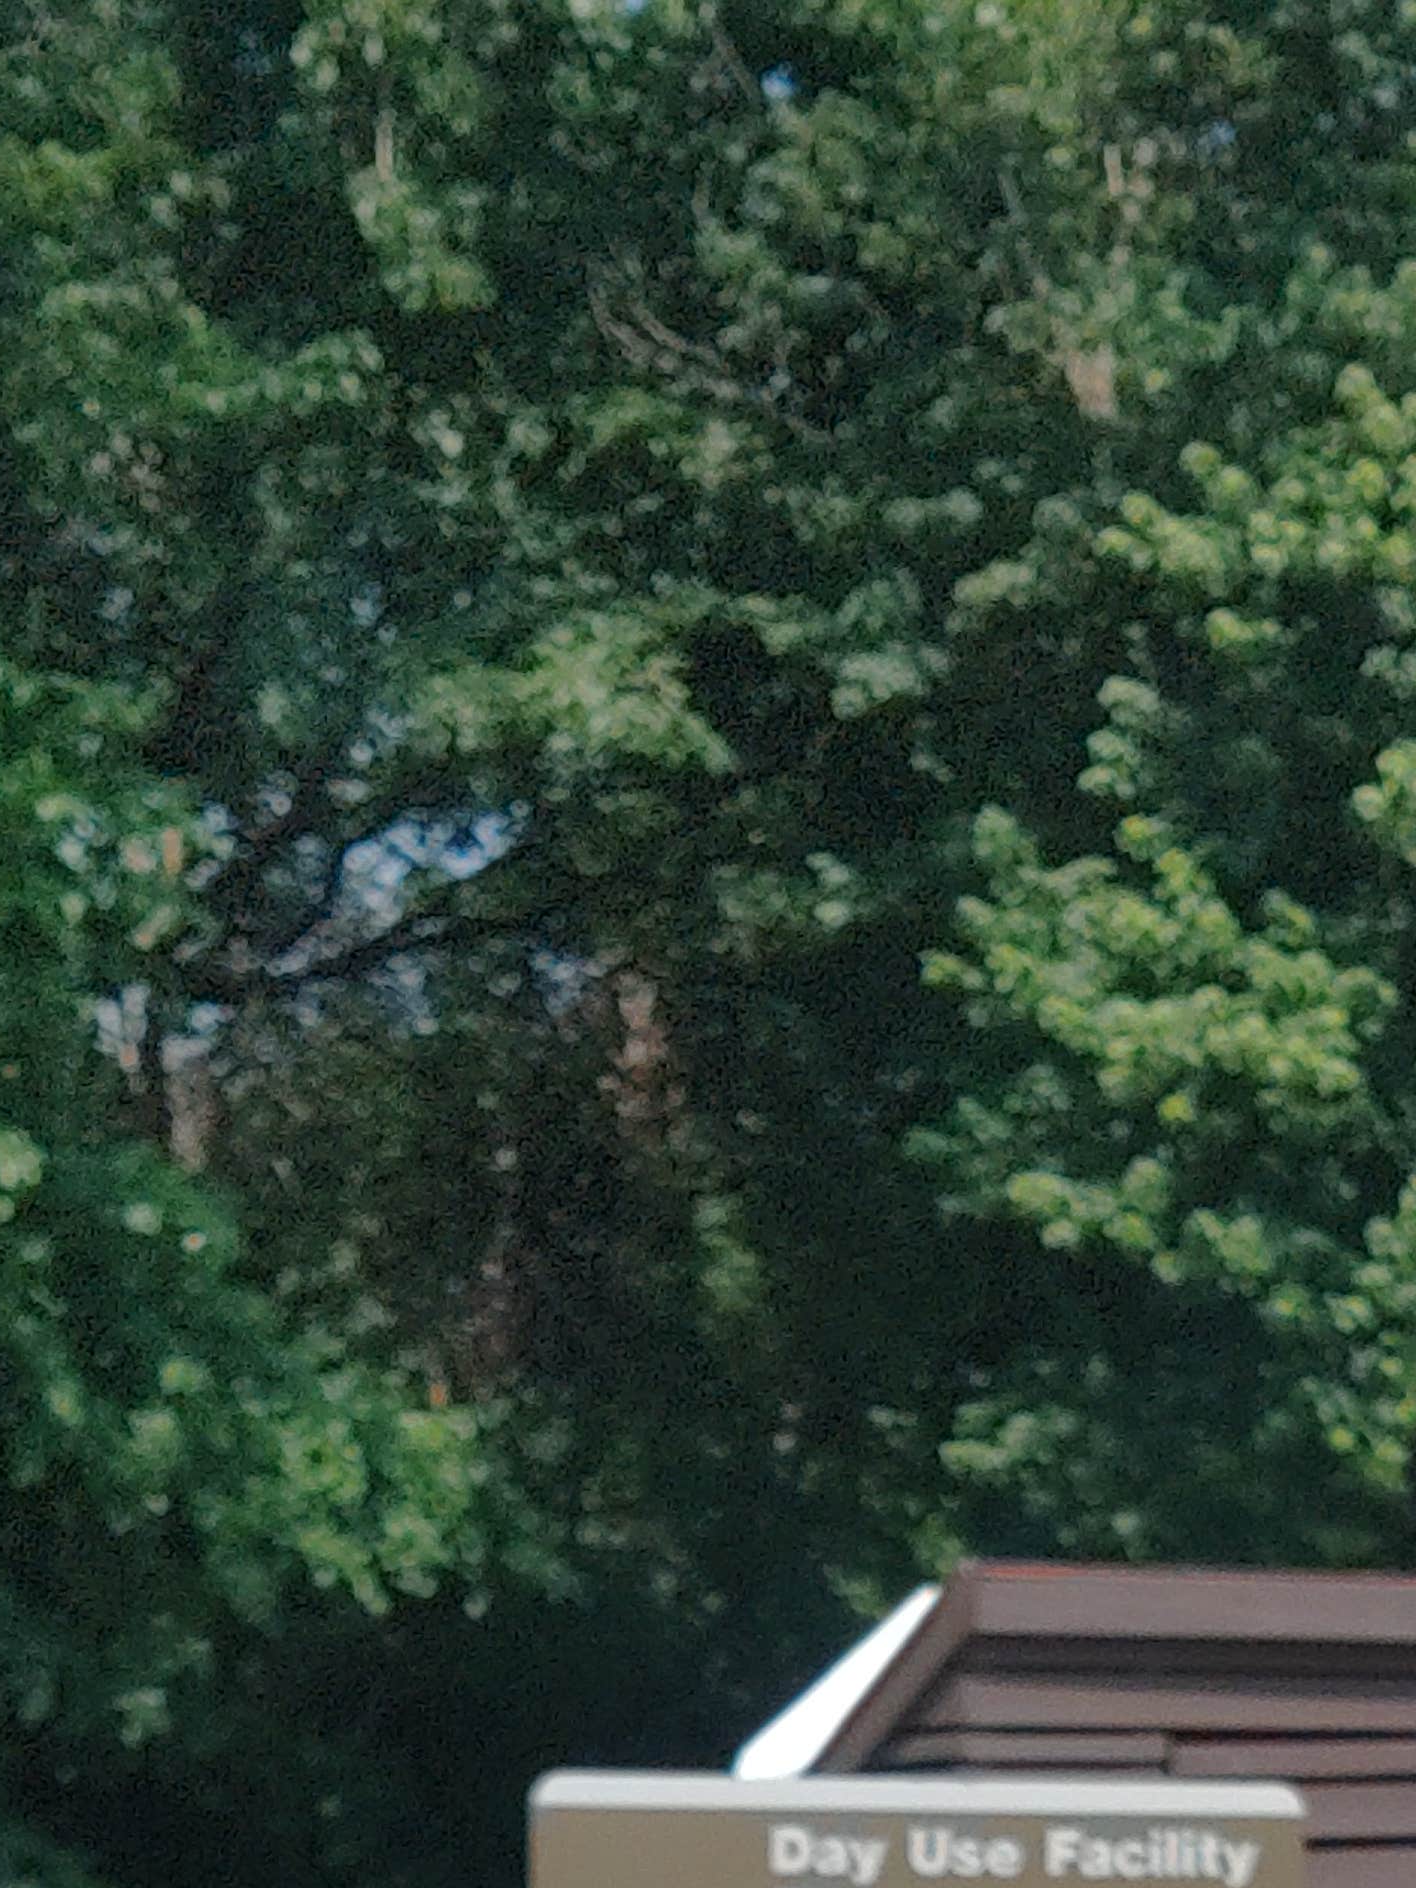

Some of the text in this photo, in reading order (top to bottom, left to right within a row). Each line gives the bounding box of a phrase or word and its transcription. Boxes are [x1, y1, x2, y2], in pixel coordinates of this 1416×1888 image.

[767, 1822, 1262, 1888] Day Use Facility
